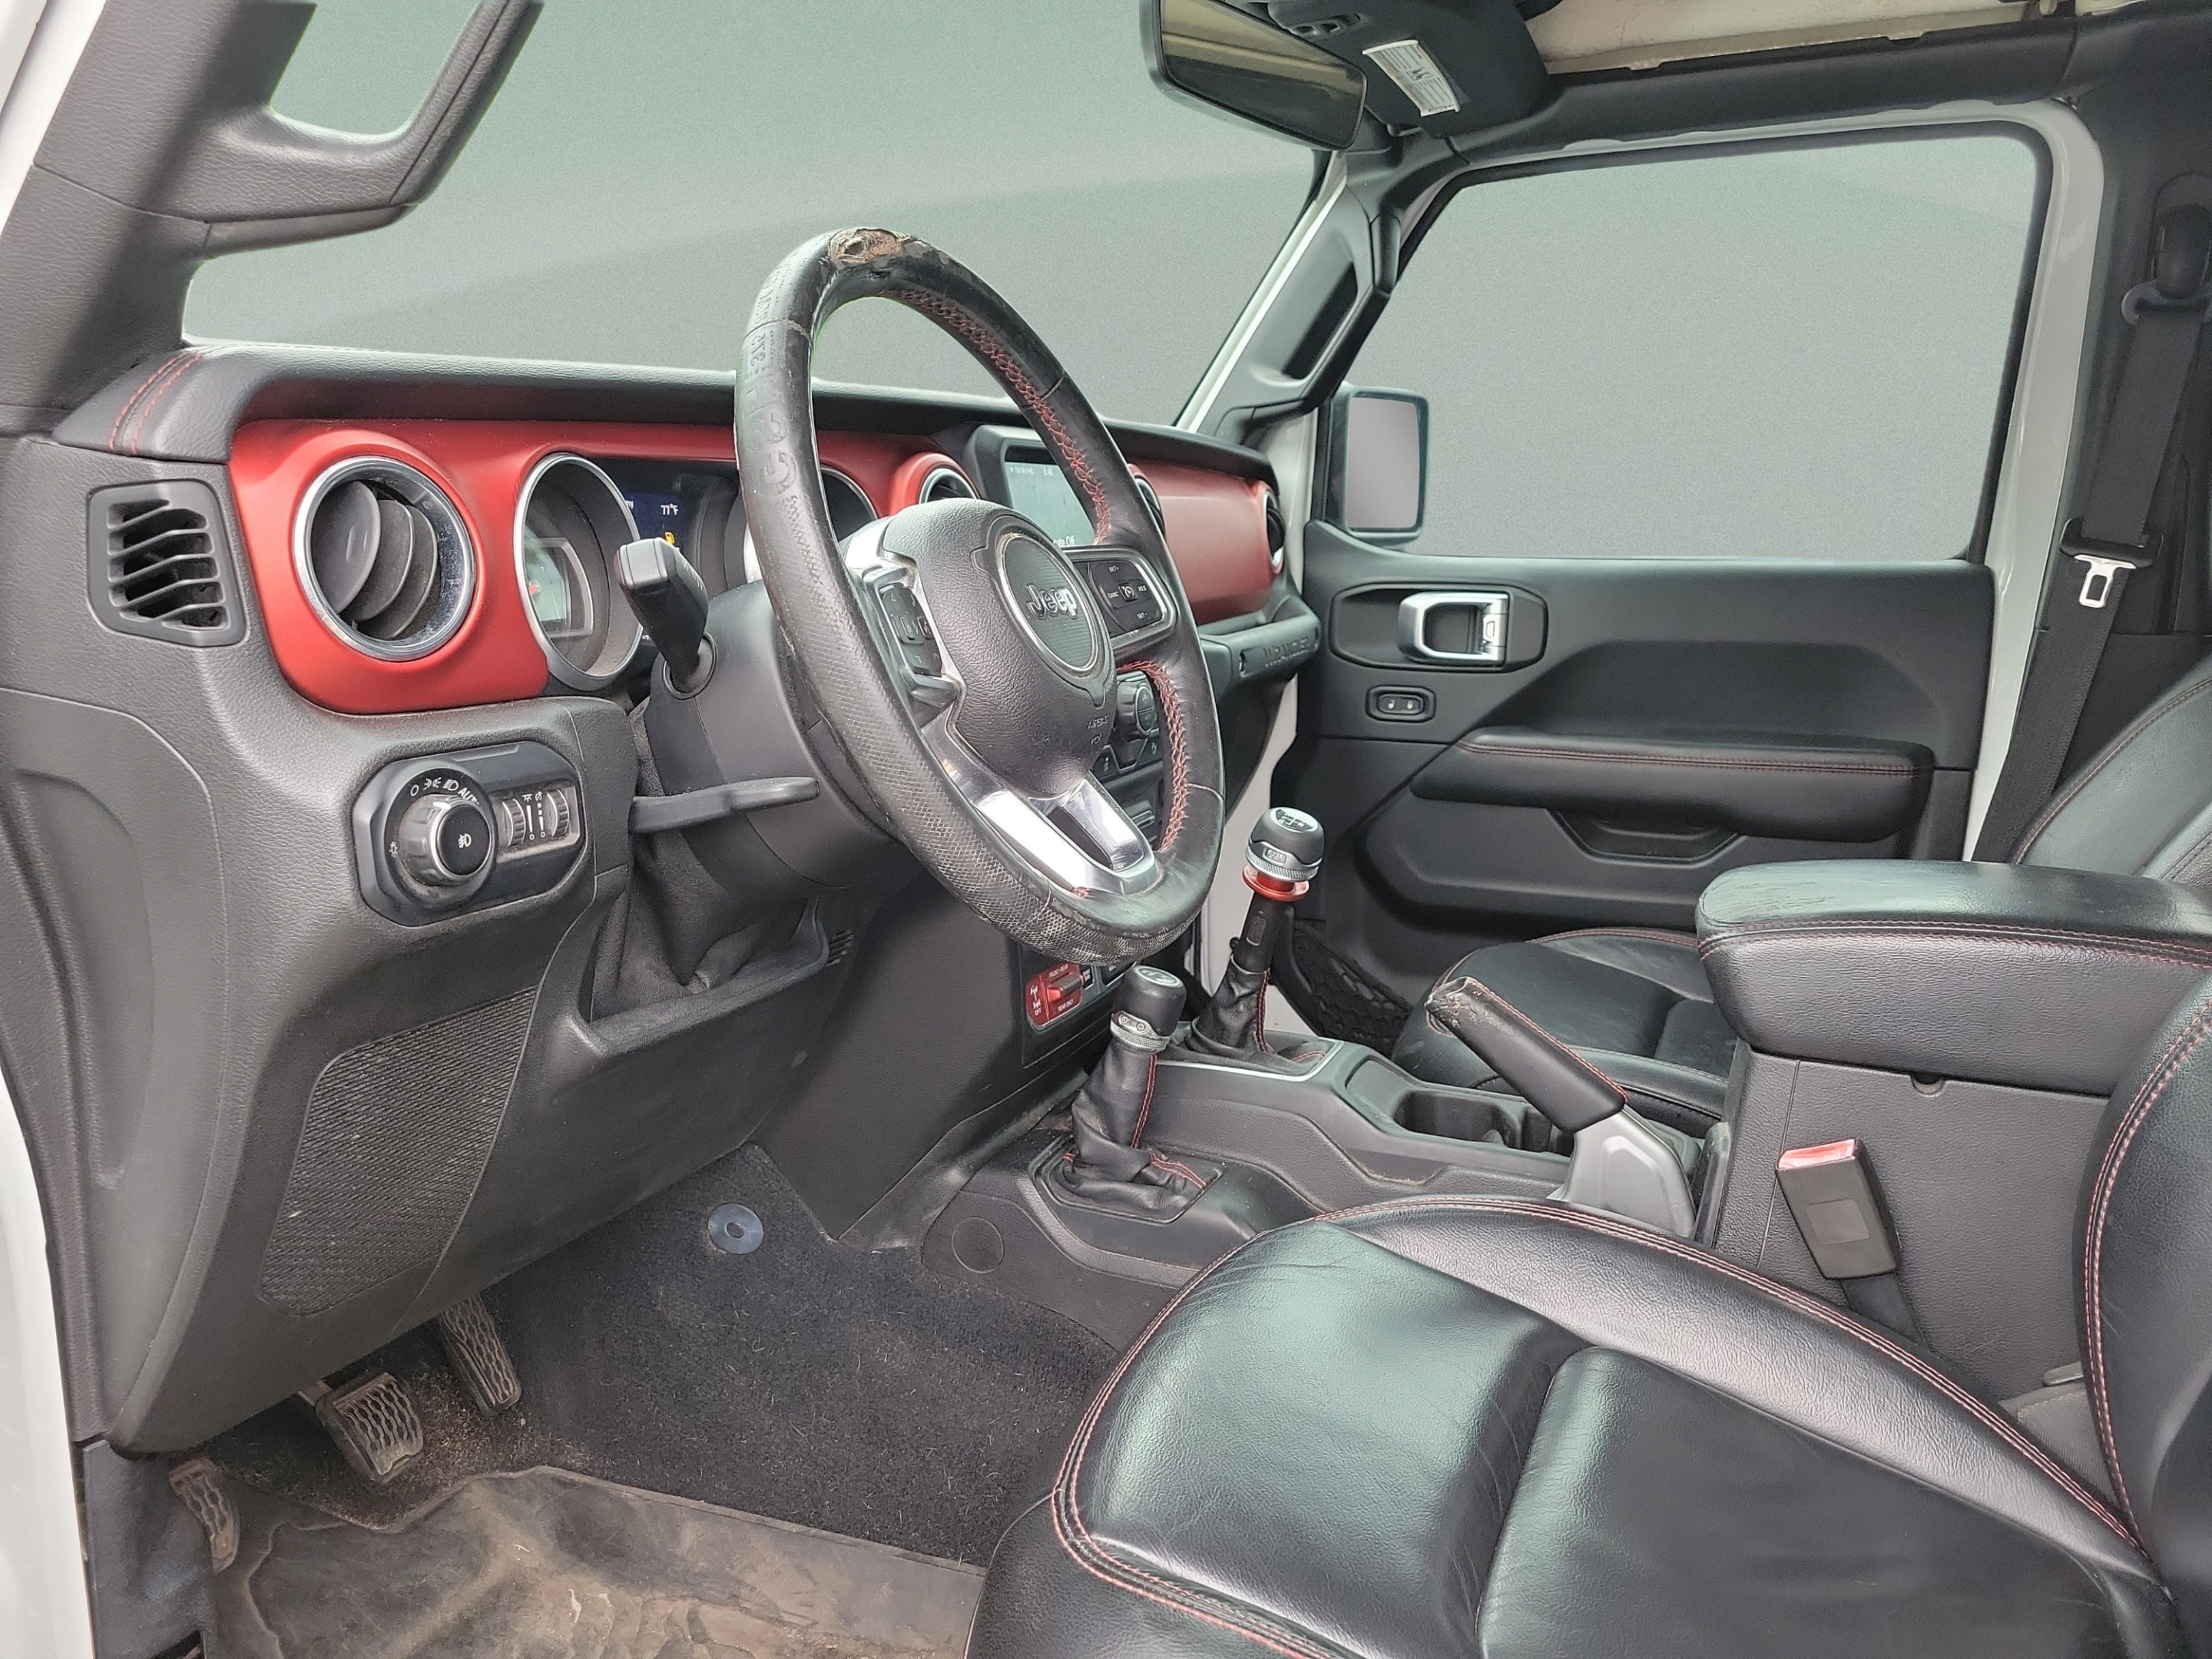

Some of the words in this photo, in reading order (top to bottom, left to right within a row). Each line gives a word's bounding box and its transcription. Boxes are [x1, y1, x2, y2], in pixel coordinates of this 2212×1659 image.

[661, 503, 679, 515] 77°F
[1026, 584, 1078, 620] Jeep
[457, 787, 480, 805] AUT
[1034, 1008, 1042, 1016] OFF
